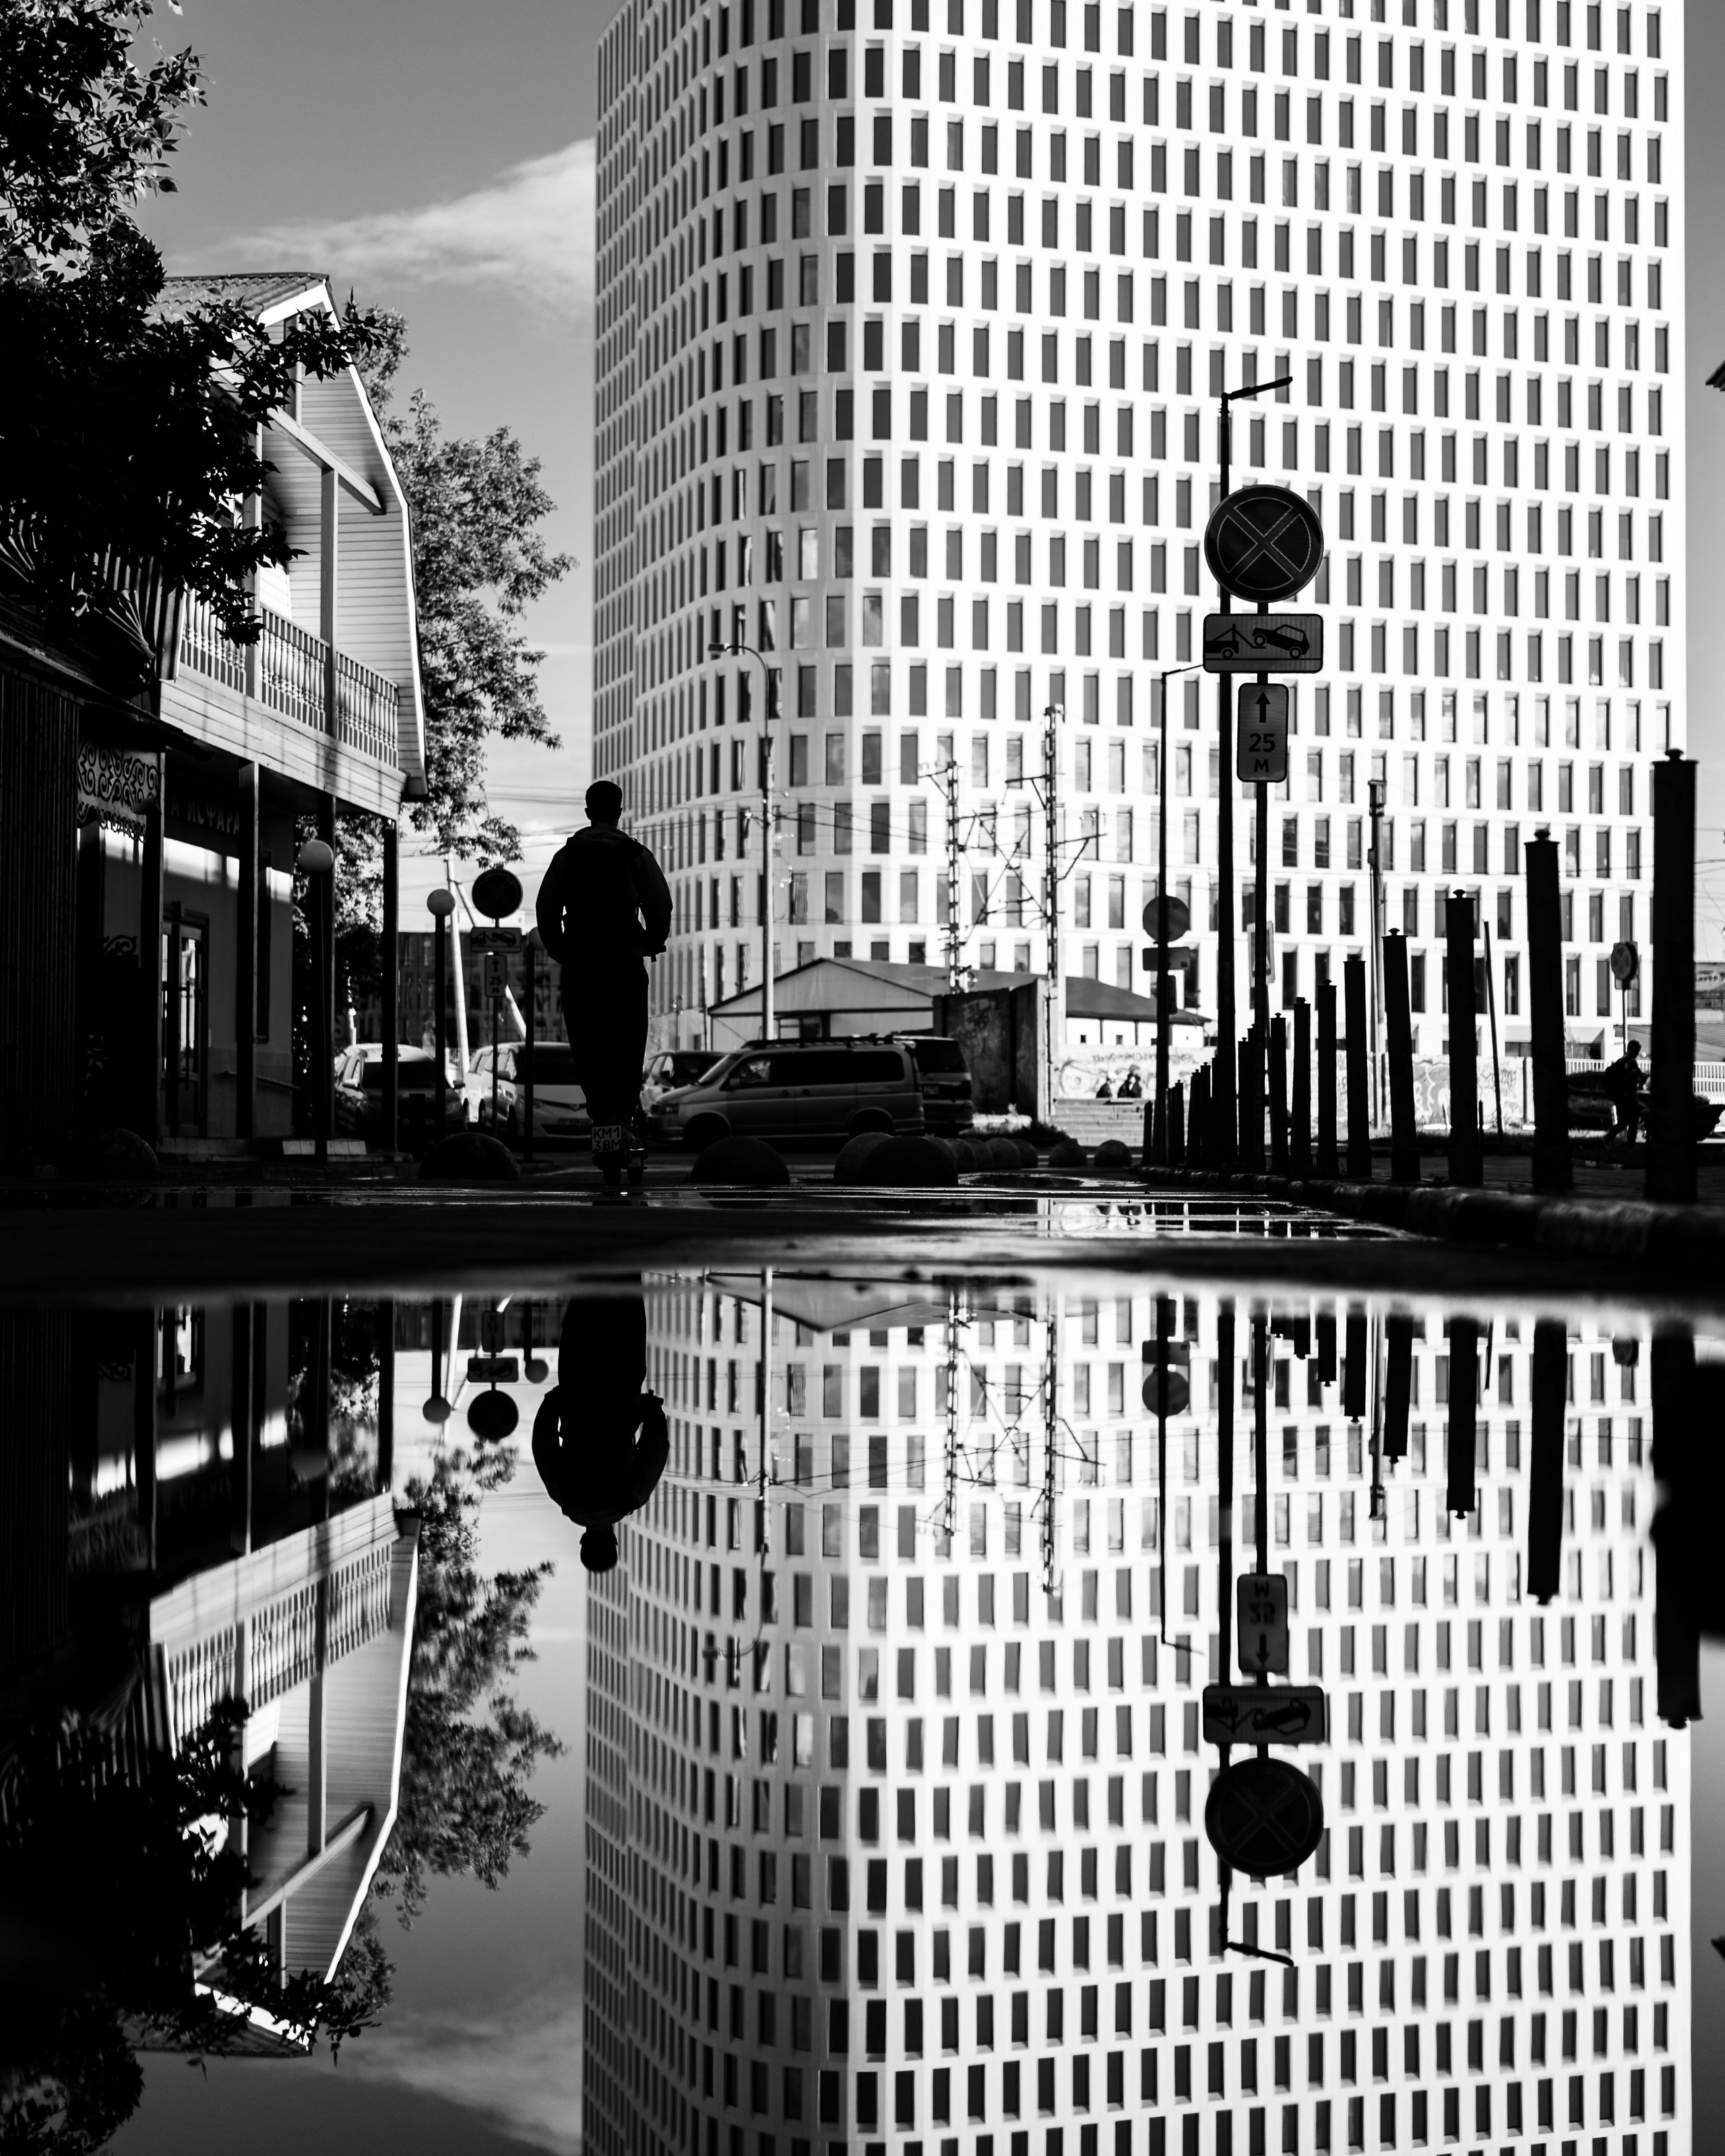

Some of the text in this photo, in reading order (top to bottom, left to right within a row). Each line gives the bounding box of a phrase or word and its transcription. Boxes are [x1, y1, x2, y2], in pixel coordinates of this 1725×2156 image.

[1249, 733, 1275, 753] 25
[1254, 759, 1269, 772] М
[490, 976, 502, 985] 25
